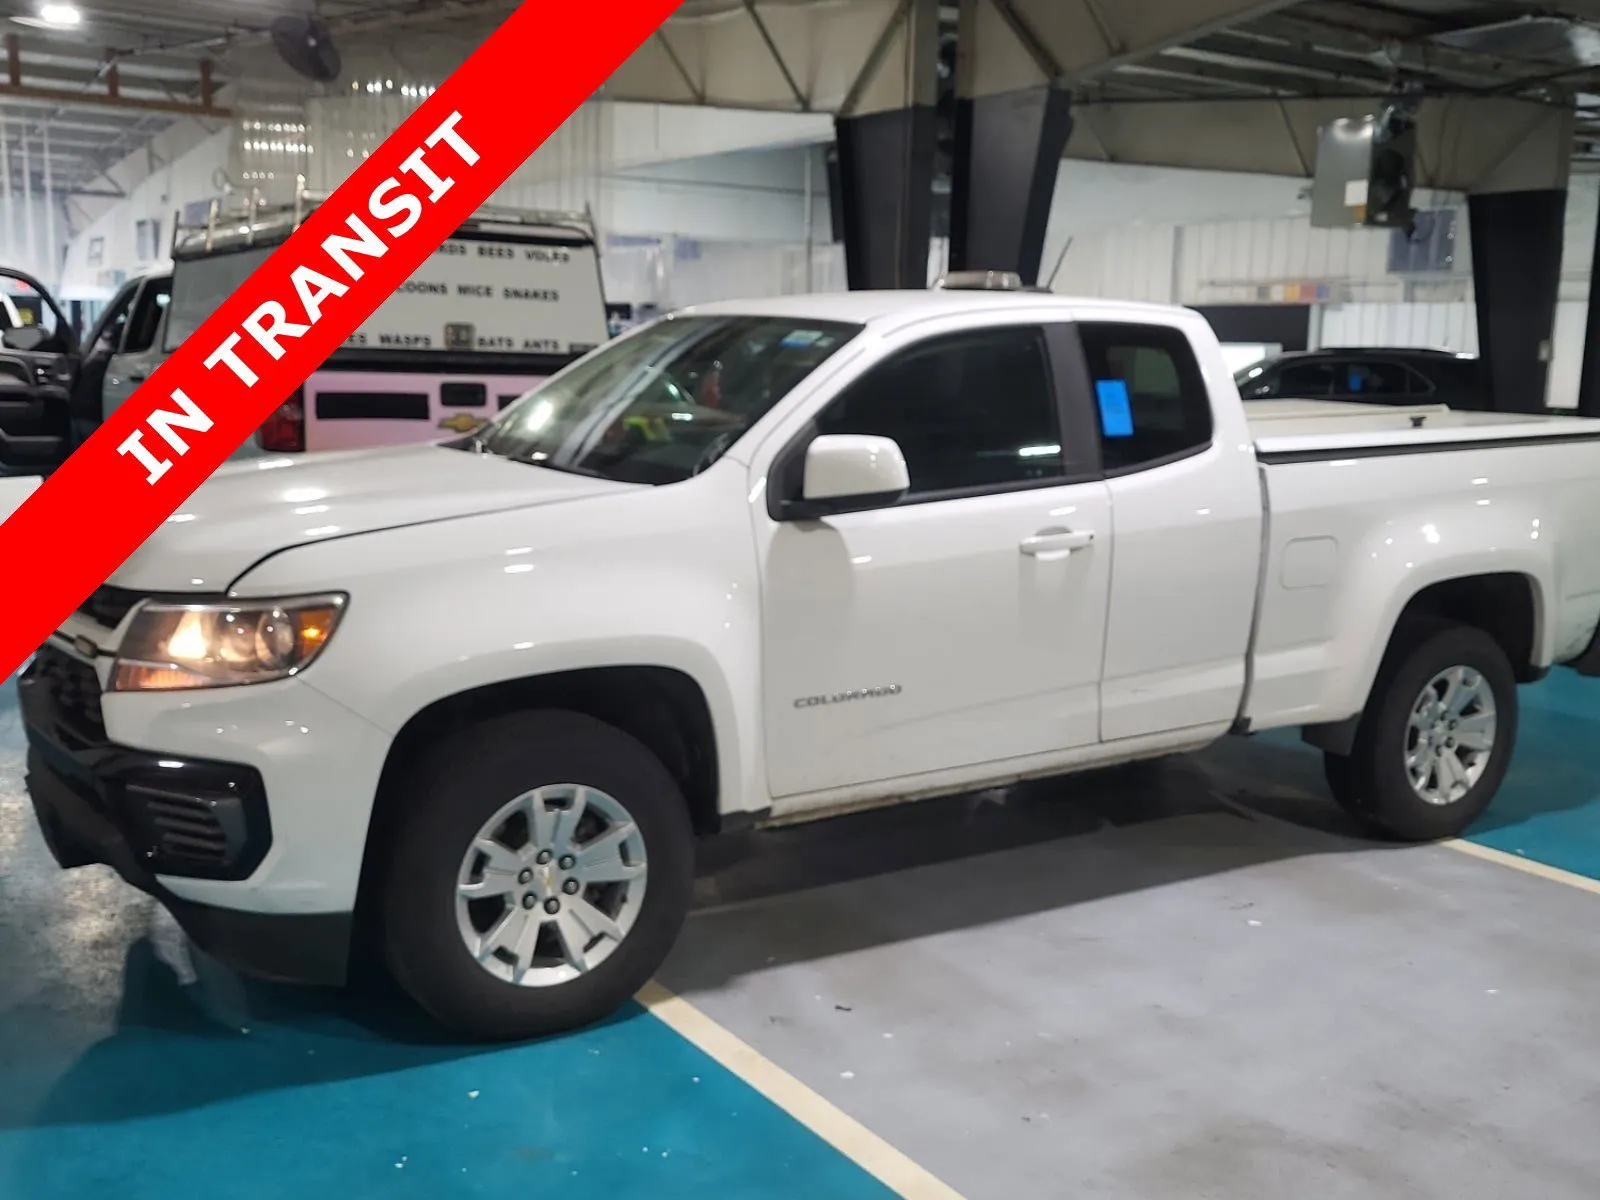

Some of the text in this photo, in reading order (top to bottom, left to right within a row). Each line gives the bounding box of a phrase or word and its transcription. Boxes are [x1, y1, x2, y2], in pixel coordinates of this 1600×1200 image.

[478, 245, 514, 259] BEES
[457, 284, 493, 298] MICE
[503, 287, 560, 301] SNAKES
[379, 332, 431, 346] WASPS
[478, 336, 514, 348] BATS
[523, 338, 560, 350] ANTS
[793, 684, 902, 709] COLORADO
